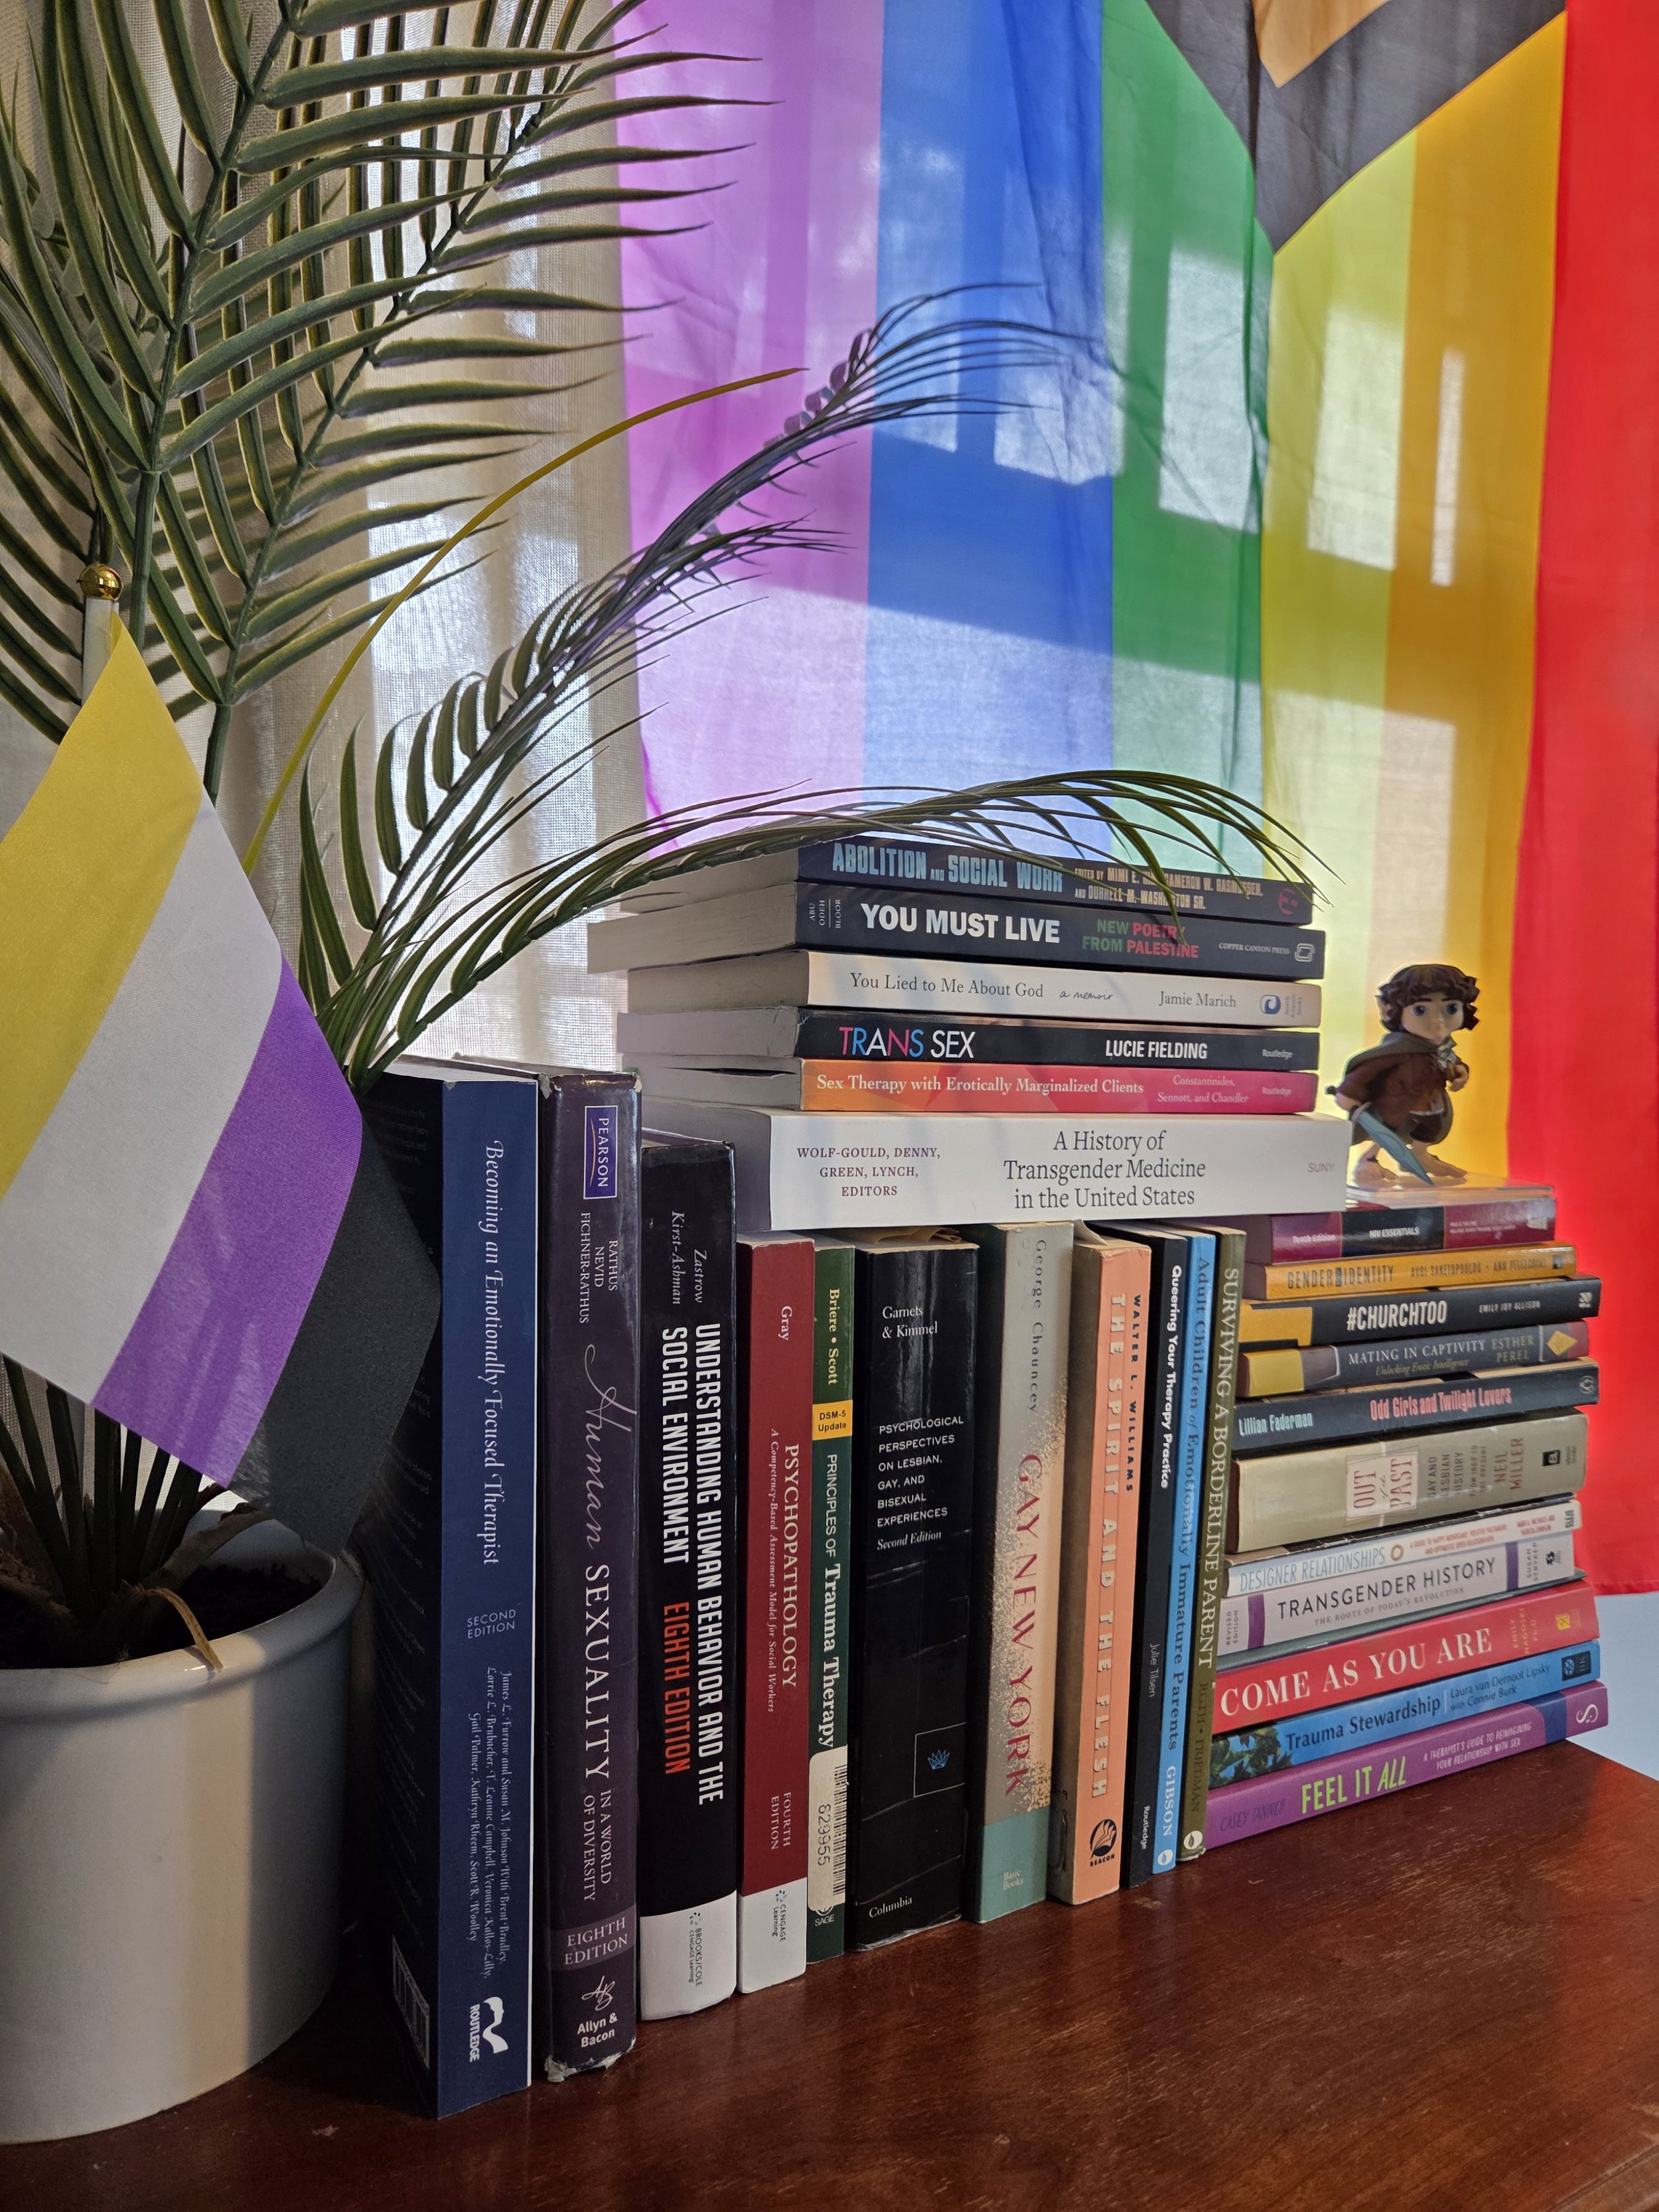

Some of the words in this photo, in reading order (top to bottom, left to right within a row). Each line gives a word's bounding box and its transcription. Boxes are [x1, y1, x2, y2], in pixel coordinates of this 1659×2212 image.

[833, 843, 926, 879] ABOLITION
[930, 868, 945, 882] AND
[948, 855, 1008, 887] SOCIAL
[861, 903, 917, 932] YOU
[926, 909, 999, 938] MUST
[1005, 916, 1060, 944] LIVE
[1082, 936, 1123, 952] FROM
[1127, 940, 1199, 958] PALESTINE
[1097, 919, 1128, 934] NEW
[850, 972, 878, 988] You
[885, 974, 917, 991] Lied
[923, 978, 936, 992] to
[941, 978, 964, 994] Me
[968, 980, 1010, 996] About
[1016, 983, 1043, 997] God
[1159, 991, 1192, 1007] Jamie
[1196, 993, 1236, 1007] Marich
[839, 1027, 924, 1057] TRANS
[930, 1029, 975, 1059] SEX
[1106, 1039, 1144, 1058] LUCIE
[1148, 1041, 1208, 1059] FIELDING
[817, 1075, 843, 1090] Sex
[848, 1075, 906, 1094] Therapy
[911, 1076, 941, 1091] with
[946, 1077, 1012, 1094] Erotically
[1016, 1078, 1098, 1096] Marginalized
[1102, 1080, 1143, 1094] Clients
[597, 1117, 609, 1188] PEARSON
[797, 1147, 889, 1159] WOLF-GOULD,
[894, 1147, 941, 1159] DENNY,
[1053, 1131, 1068, 1151] A
[1073, 1131, 1143, 1156] History
[1147, 1130, 1167, 1150] of
[1307, 1162, 1335, 1173] SUNY
[478, 1140, 504, 1234] Becoming
[820, 1167, 868, 1179] GREEN,
[872, 1167, 918, 1178] LYNCH,
[841, 1186, 897, 1197] EDITORS
[1003, 1159, 1122, 1186] Transgender
[1126, 1158, 1206, 1179] Medicine
[1015, 1191, 1032, 1209] in
[1039, 1187, 1069, 1208] the
[1076, 1187, 1137, 1208] United
[1143, 1186, 1194, 1206] States
[486, 1240, 498, 1264] an
[1382, 1226, 1419, 1237] ESSENTIALS
[579, 1212, 590, 1324] FICHNER-RATHUS
[594, 1246, 604, 1287] NEVID
[609, 1240, 618, 1291] RATHUS
[672, 1211, 685, 1305] Kirst-Ashman
[693, 1249, 707, 1303] Zastrow
[1032, 1239, 1046, 1309] George
[1288, 1268, 1333, 1289] GENDER
[1343, 1265, 1394, 1286] IDENTITY
[828, 1288, 840, 1333] Briere
[1167, 1264, 1183, 1333] Queering
[1195, 1258, 1210, 1315] Adult
[478, 1270, 506, 1386] Emotionally
[778, 1305, 793, 1341] Gray
[882, 1305, 924, 1320] Garnets
[882, 1325, 893, 1339] &
[896, 1321, 938, 1337] Kimmel
[1110, 1293, 1125, 1354] THE
[1216, 1268, 1239, 1398] SURVIVING
[1347, 1300, 1447, 1331] #CHURCHTOO
[662, 1327, 688, 1407] SOCIAL
[828, 1348, 840, 1385] Scott
[1027, 1322, 1044, 1412] Chauncey
[1166, 1335, 1179, 1370] Your
[1190, 1320, 1207, 1410] Children
[1348, 1348, 1399, 1364] MATING
[1404, 1347, 1417, 1359] IN
[1422, 1339, 1485, 1357] CAPTIVITY
[1491, 1335, 1534, 1350] ESTHER
[1496, 1350, 1529, 1363] PEREL
[695, 1323, 721, 1503] UNDERSTANDING
[819, 1409, 847, 1421] DSM-5
[879, 1415, 964, 1435] PSYCHOLOGICAL
[1163, 1370, 1177, 1432] Therapy
[1189, 1414, 1196, 1432] of
[1214, 1410, 1229, 1422] A
[1238, 1416, 1267, 1436] Lillian
[1269, 1412, 1313, 1432] Faderman
[1370, 1398, 1390, 1421] Odd
[1394, 1395, 1418, 1418] Girls
[1419, 1392, 1437, 1414] and
[1438, 1388, 1477, 1412] Twilight
[1479, 1387, 1512, 1406] Lovers
[484, 1390, 505, 1467] Focused
[584, 1343, 638, 1550] Human
[818, 1420, 847, 1434] Update
[879, 1434, 956, 1453] PERSPECTIVES
[1104, 1377, 1123, 1495] SPIRIT
[877, 1477, 901, 1491] GAY,
[903, 1475, 926, 1487] AND
[878, 1461, 894, 1472] ON
[897, 1455, 943, 1470] LESBIAN,
[1160, 1432, 1173, 1490] Practice
[1390, 1458, 1412, 1508] PAST
[662, 1412, 689, 1564] ENVIRONMENT
[825, 1453, 837, 1535] PRINCIPLES
[877, 1493, 927, 1509] BISEXUAL
[1017, 1453, 1043, 1538] GAY
[1178, 1434, 1199, 1556] Emotionally
[1204, 1424, 1228, 1576] BORDERLINE
[1353, 1470, 1376, 1509] OUT
[476, 1473, 505, 1565] Therapist
[877, 1507, 948, 1527] EXPERIENCES
[696, 1510, 722, 1591] HUMAN
[782, 1443, 800, 1688] PSYCHOPATHOLOGY
[825, 1538, 837, 1558] OF
[1100, 1518, 1118, 1587] AND
[1240, 1564, 1297, 1592] DESIGNER
[1302, 1546, 1386, 1580] RELATIONSHIPS
[823, 1562, 841, 1653] Trauma
[1012, 1552, 1037, 1651] NEW
[1173, 1561, 1191, 1664] Immature
[1277, 1574, 1415, 1620] TRANSGENDER
[1423, 1557, 1496, 1588] HISTORY
[663, 1601, 689, 1682] EIGHTH
[1098, 1609, 1114, 1673] THE
[1198, 1579, 1218, 1669] PARENT
[584, 1564, 610, 1779] SEXUALITY
[697, 1595, 722, 1707] BEHAVIOR
[1220, 1670, 1311, 1716] COME
[1322, 1659, 1359, 1693] AS
[1369, 1643, 1436, 1680] YOU
[1437, 1628, 1492, 1664] ARE
[818, 1657, 839, 1748] Therapy
[1168, 1670, 1185, 1752] Parents
[1285, 1724, 1344, 1751] Trauma
[1350, 1696, 1441, 1735] Stewardship
[664, 1686, 691, 1775] EDITION
[697, 1711, 723, 1757] AND
[1005, 1665, 1033, 1795] YORK
[1092, 1694, 1110, 1799] FLESH
[698, 1761, 723, 1805] THE
[1163, 1765, 1177, 1837] GIBSON
[1302, 1775, 1348, 1814] FEEL
[1355, 1765, 1372, 1798] IT
[1377, 1756, 1406, 1793] ALL
[816, 1803, 831, 1866] 829955
[1141, 1805, 1150, 1850] Routledge
[469, 2004, 480, 2063] ROUTLEDGE
